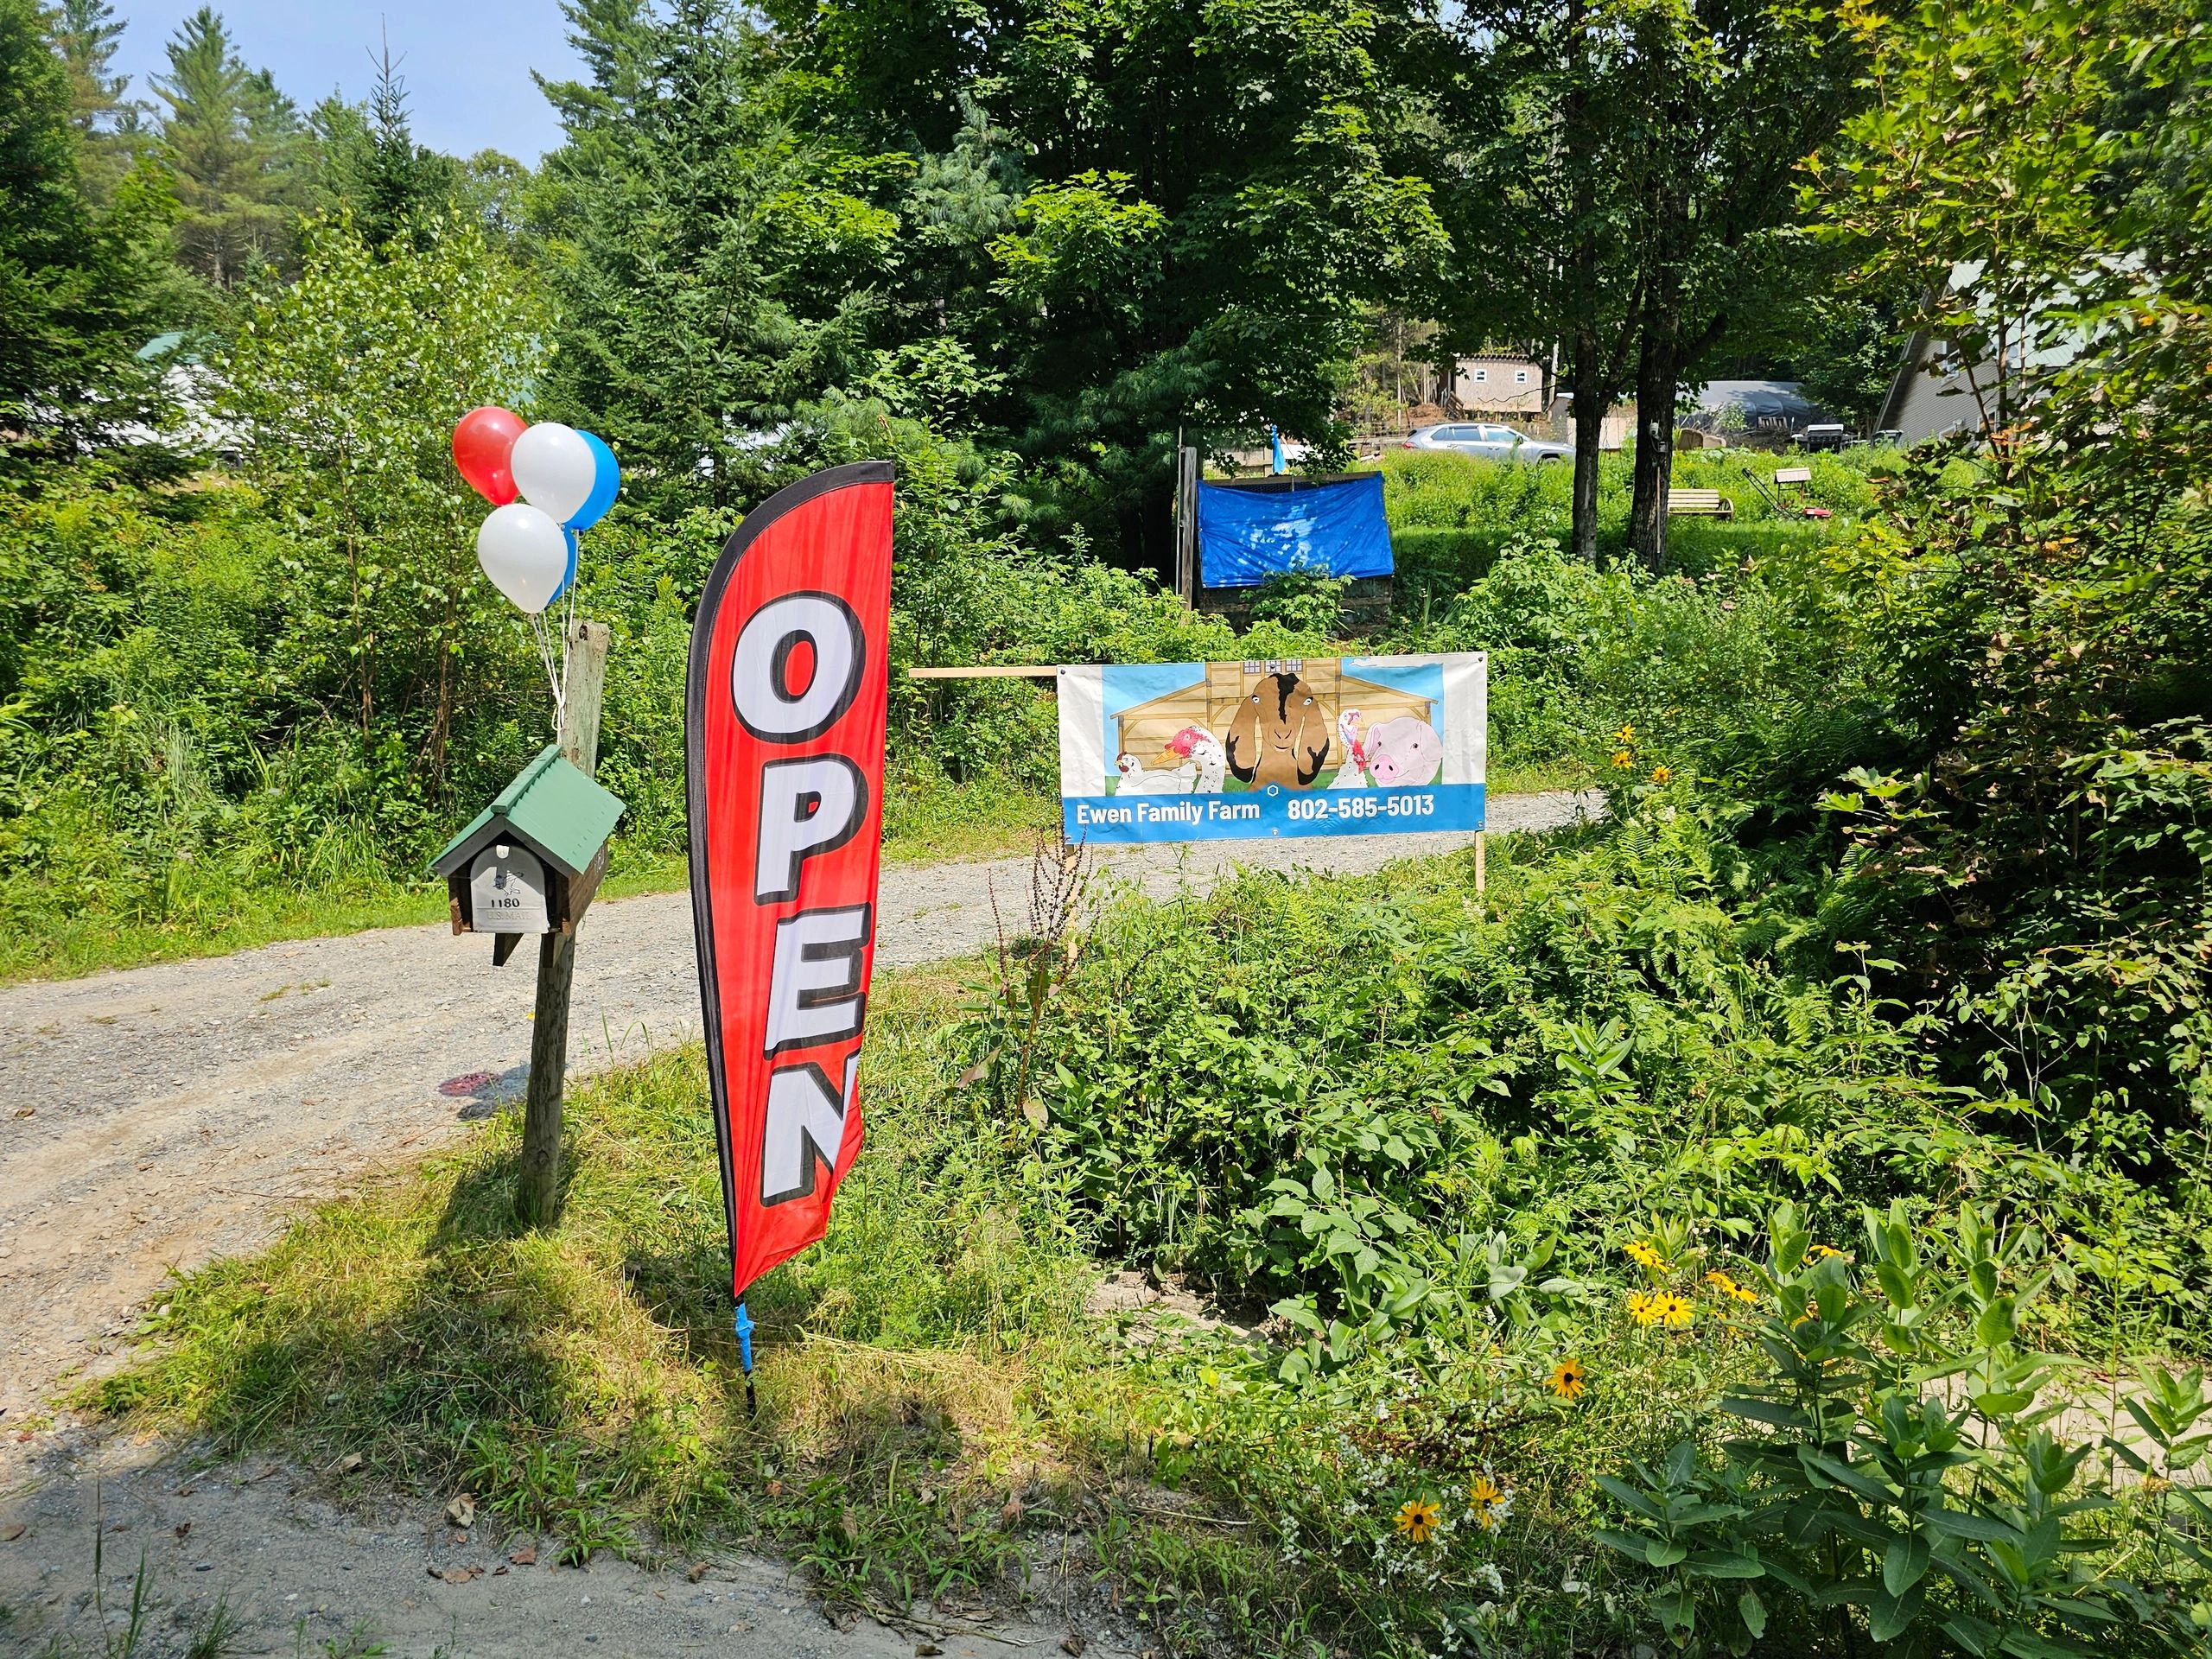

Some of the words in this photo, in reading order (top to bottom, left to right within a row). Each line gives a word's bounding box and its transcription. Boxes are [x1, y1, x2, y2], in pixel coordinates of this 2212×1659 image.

[1077, 804, 1132, 824] Ewen
[1137, 801, 1203, 825] Family
[1209, 800, 1260, 820] Farm
[1287, 794, 1434, 820] 802-585-5013
[491, 898, 520, 908] 1180
[732, 590, 870, 1207] OPEN
[505, 911, 532, 920] MAIL
